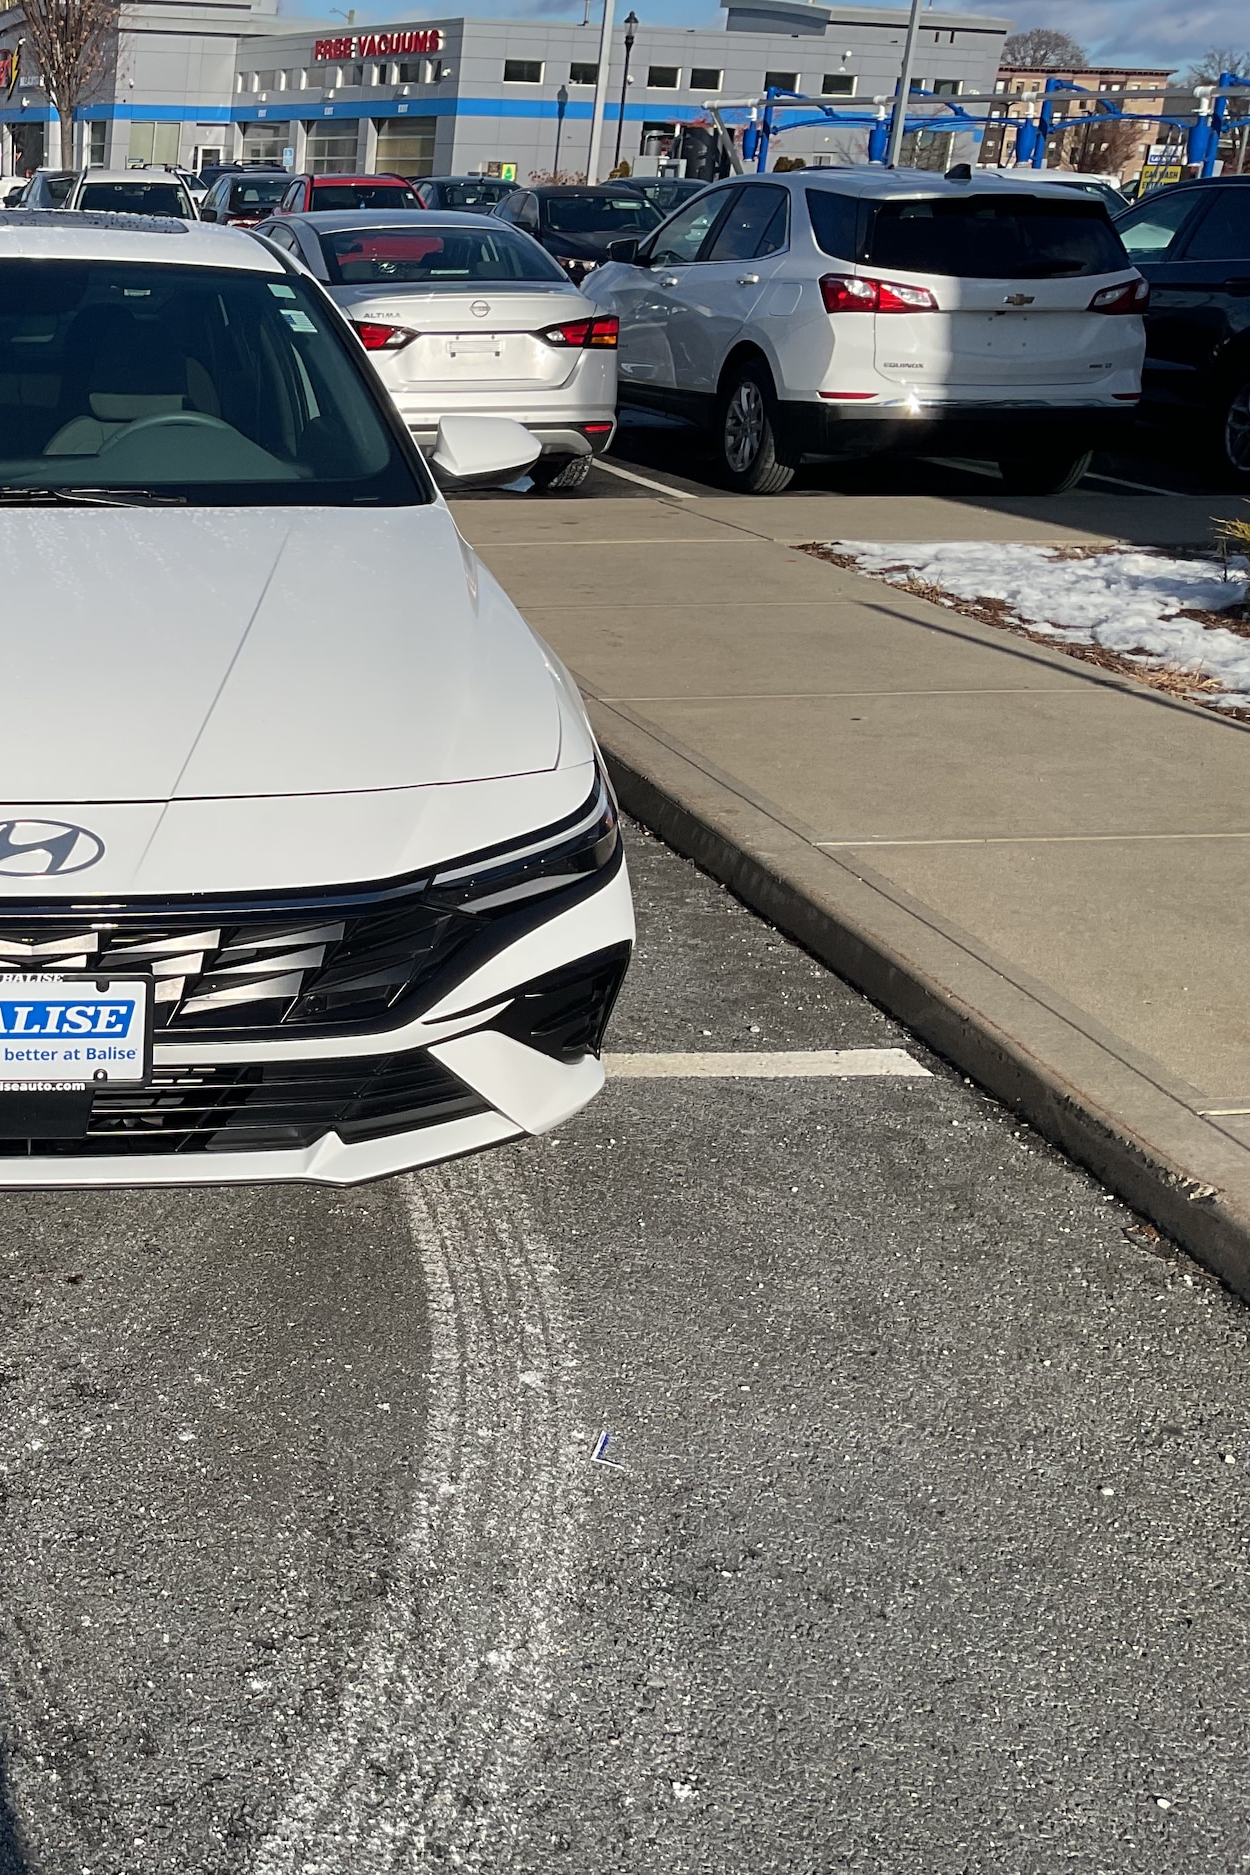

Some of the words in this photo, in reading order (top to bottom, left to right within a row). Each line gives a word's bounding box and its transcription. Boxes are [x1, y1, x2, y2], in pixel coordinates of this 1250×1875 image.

[315, 37, 356, 60] FREE
[358, 30, 444, 57] VACUUMS
[362, 312, 403, 320] ALTIMA
[2, 973, 65, 983] BALISE
[4, 1047, 58, 1061] better
[63, 1048, 80, 1060] at
[86, 1046, 136, 1060] Balise
